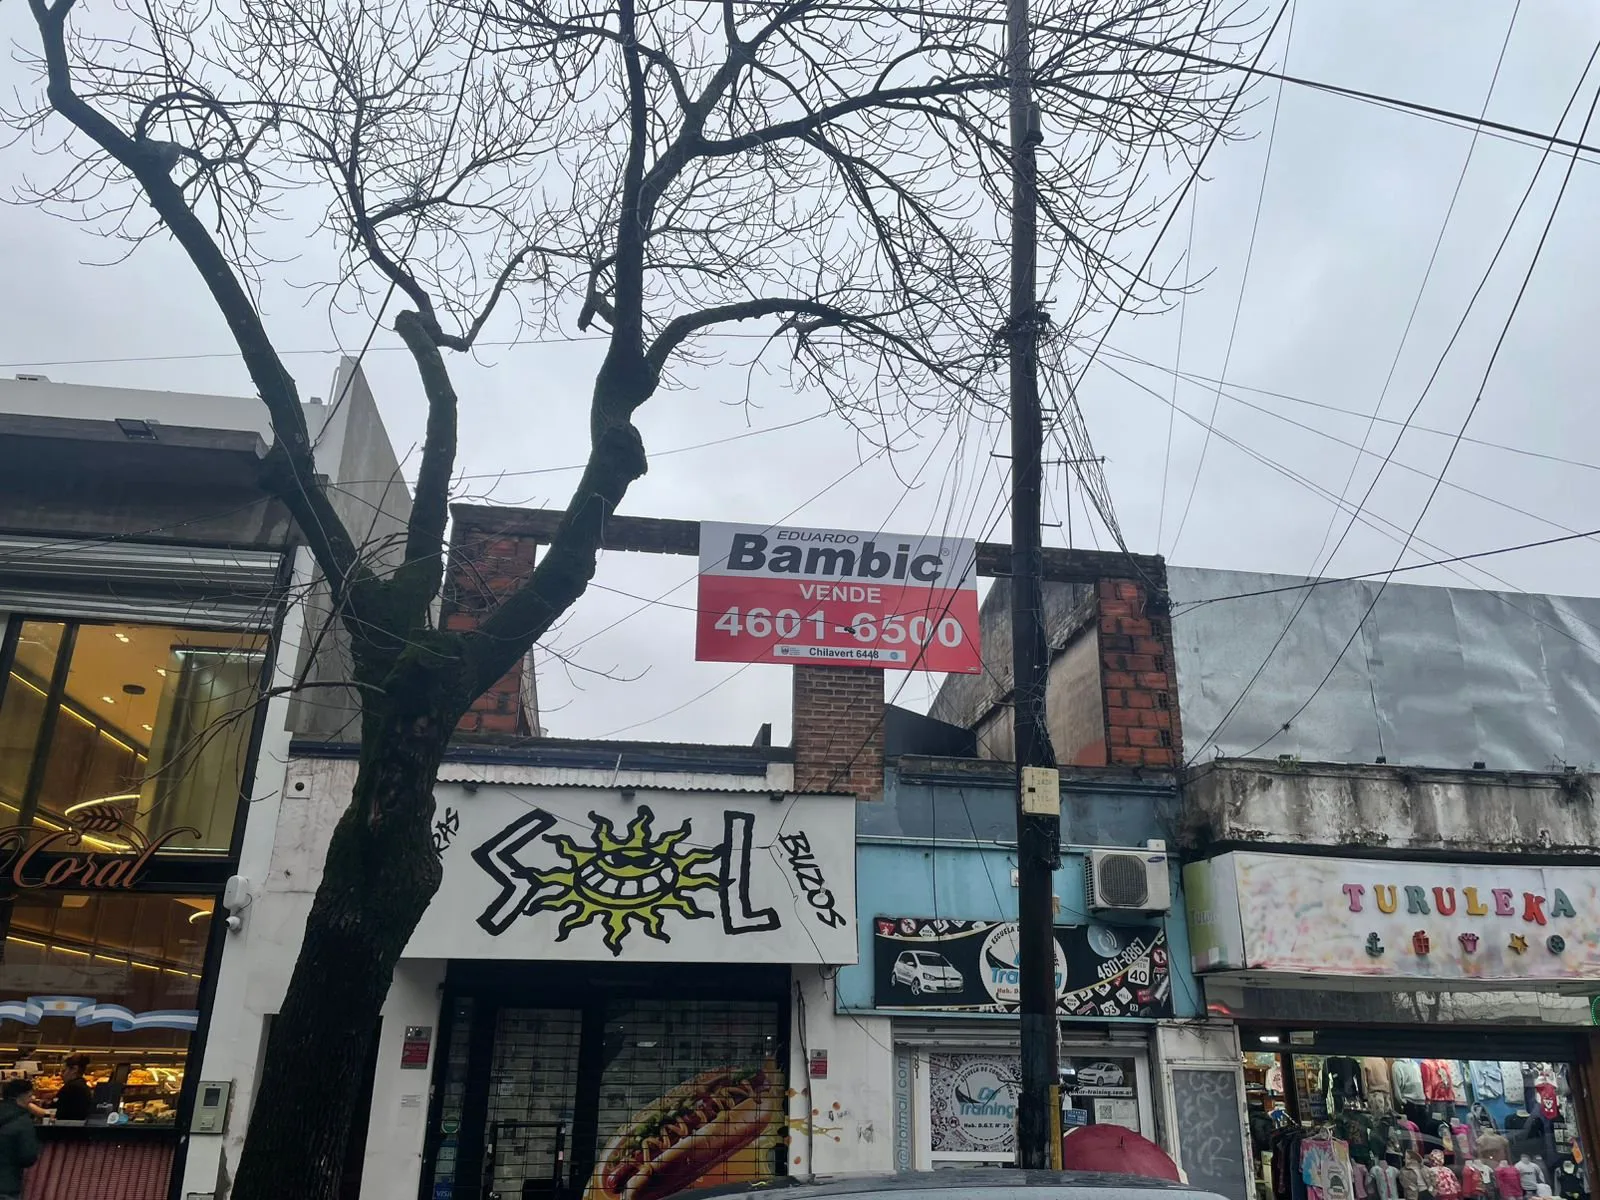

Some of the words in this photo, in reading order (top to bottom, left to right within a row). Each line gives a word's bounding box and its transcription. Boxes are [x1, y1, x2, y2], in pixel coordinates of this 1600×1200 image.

[777, 530, 859, 544] EDUARDO
[726, 533, 944, 582] Bambic
[799, 583, 881, 604] VENDE
[714, 606, 963, 647] 4601-6500
[809, 647, 853, 658] Chilavert
[856, 650, 879, 659] 6448
[8, 826, 202, 889] Coral
[777, 830, 847, 930] BUZOS
[1342, 883, 1578, 926] TURULEKA
[991, 926, 1015, 944] ESCUELA
[1096, 936, 1147, 980] 4601-8867
[1129, 968, 1148, 984] 40
[1103, 1004, 1118, 1015] 93
[895, 1054, 911, 1172] @hotmail.com
[959, 1102, 1017, 1120] Training
